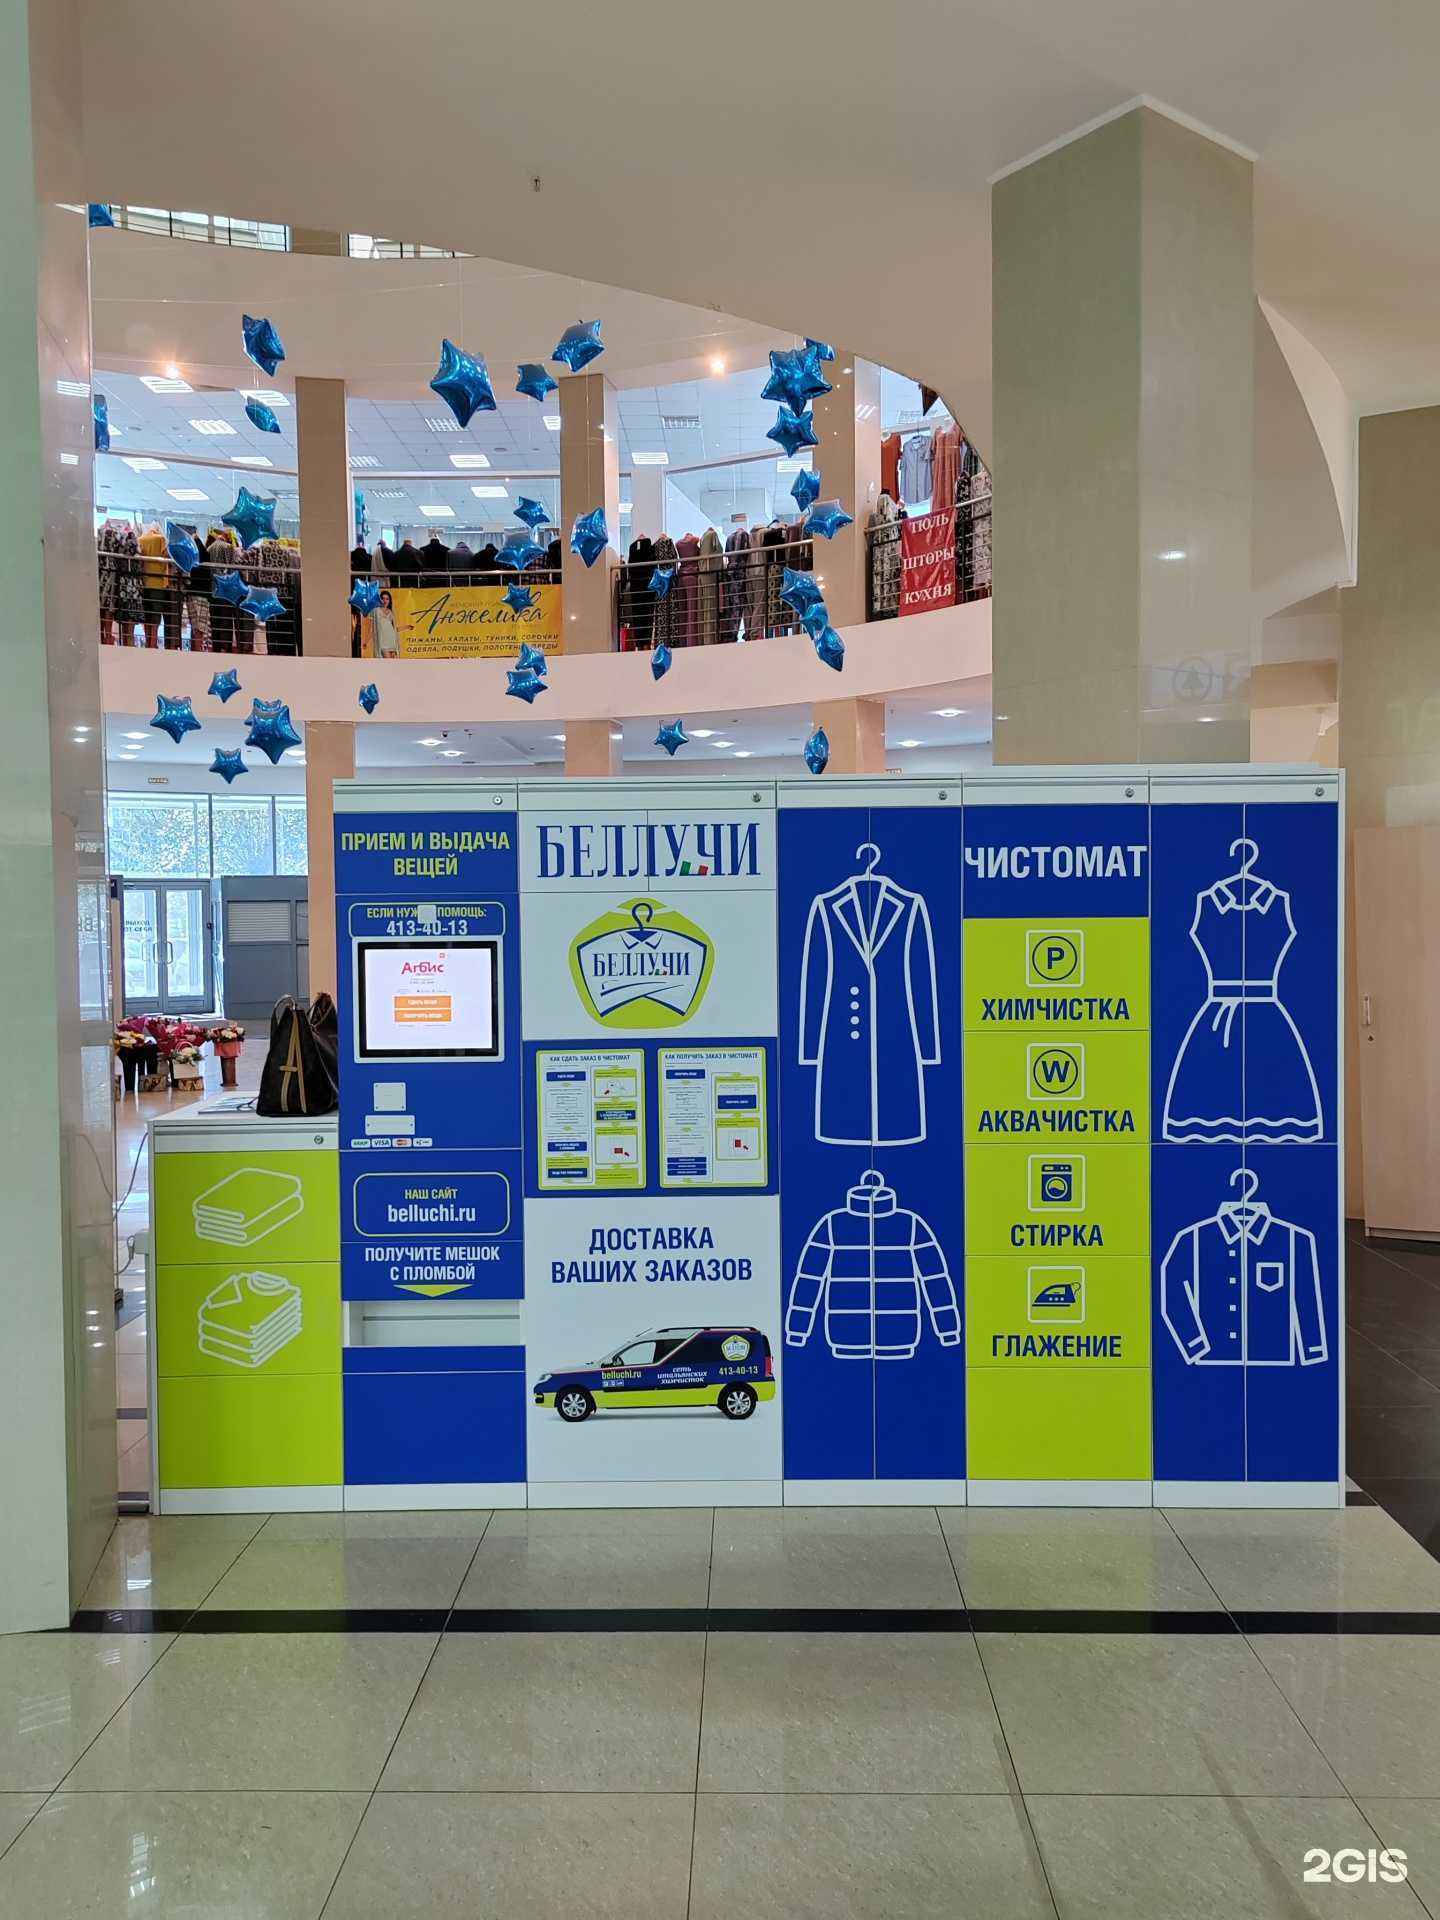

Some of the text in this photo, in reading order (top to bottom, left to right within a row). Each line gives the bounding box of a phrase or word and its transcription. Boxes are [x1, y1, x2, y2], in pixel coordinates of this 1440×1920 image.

[911, 513, 949, 534] ТЮЛЬ
[903, 546, 956, 570] ШТОРЫ
[905, 582, 952, 605] КУХНЯ
[410, 592, 547, 634] Анжелика
[341, 831, 510, 852] ПРИЕМ И ВЫДАЧА
[536, 822, 761, 878] БЕЛЛУЧИ
[393, 853, 458, 878] ВЕЩЕЙ
[964, 845, 1147, 878] ЧИСТОМАТ
[366, 906, 487, 919] ЕСЛИ НУЖ ПОМОЩЬ:
[386, 920, 468, 936] 413-40-13
[401, 962, 444, 974] Агбис
[593, 952, 690, 976] БЕЛЛУЧИ
[981, 998, 1130, 1021] ХИМЧИСТКА
[978, 1110, 1135, 1132] АКВАЧИСТКА
[404, 1186, 458, 1199] НАШ САЙТ
[387, 1204, 476, 1222] belluchi.ru
[589, 1227, 714, 1254] ДОСТАВКА
[1010, 1224, 1104, 1247] СТИРКА
[365, 1246, 500, 1262] ПОЛУЧИТЕ МЕШОК
[390, 1263, 475, 1280] С ПЛОМБОЙ
[551, 1258, 752, 1284] ВАШИХ ЗАКАЗОВ
[992, 1335, 1122, 1357] ГЛАЖЕНИЕ
[601, 1370, 642, 1379] belluchi.ru
[719, 1366, 759, 1375] 413-40-13
